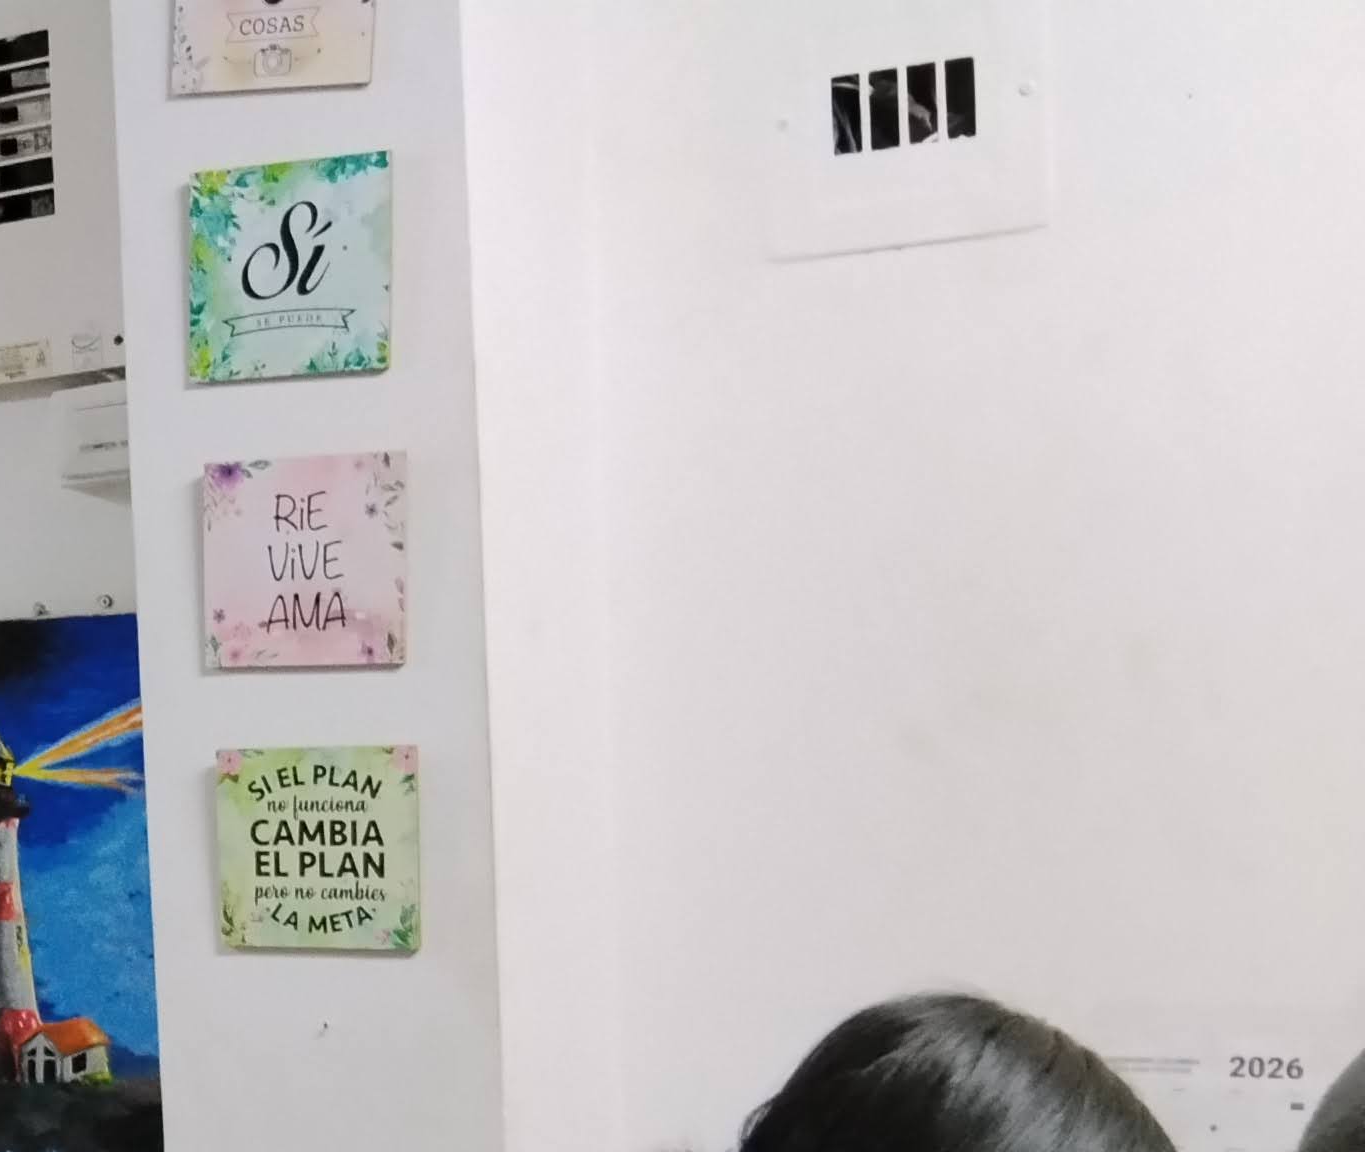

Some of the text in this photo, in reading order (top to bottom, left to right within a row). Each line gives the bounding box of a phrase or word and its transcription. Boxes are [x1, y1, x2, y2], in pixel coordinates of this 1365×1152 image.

[239, 15, 305, 36] COSAS
[242, 201, 332, 300] Sí
[267, 591, 346, 634] AMA
[248, 764, 382, 802] SI EL PLAN
[267, 795, 367, 820] no funciona
[250, 819, 385, 847] CAMBIA
[255, 851, 385, 878] EL PLAN
[255, 880, 386, 906] pero no cambies
[270, 902, 373, 934] LA META
[1229, 1056, 1304, 1080] 2026
